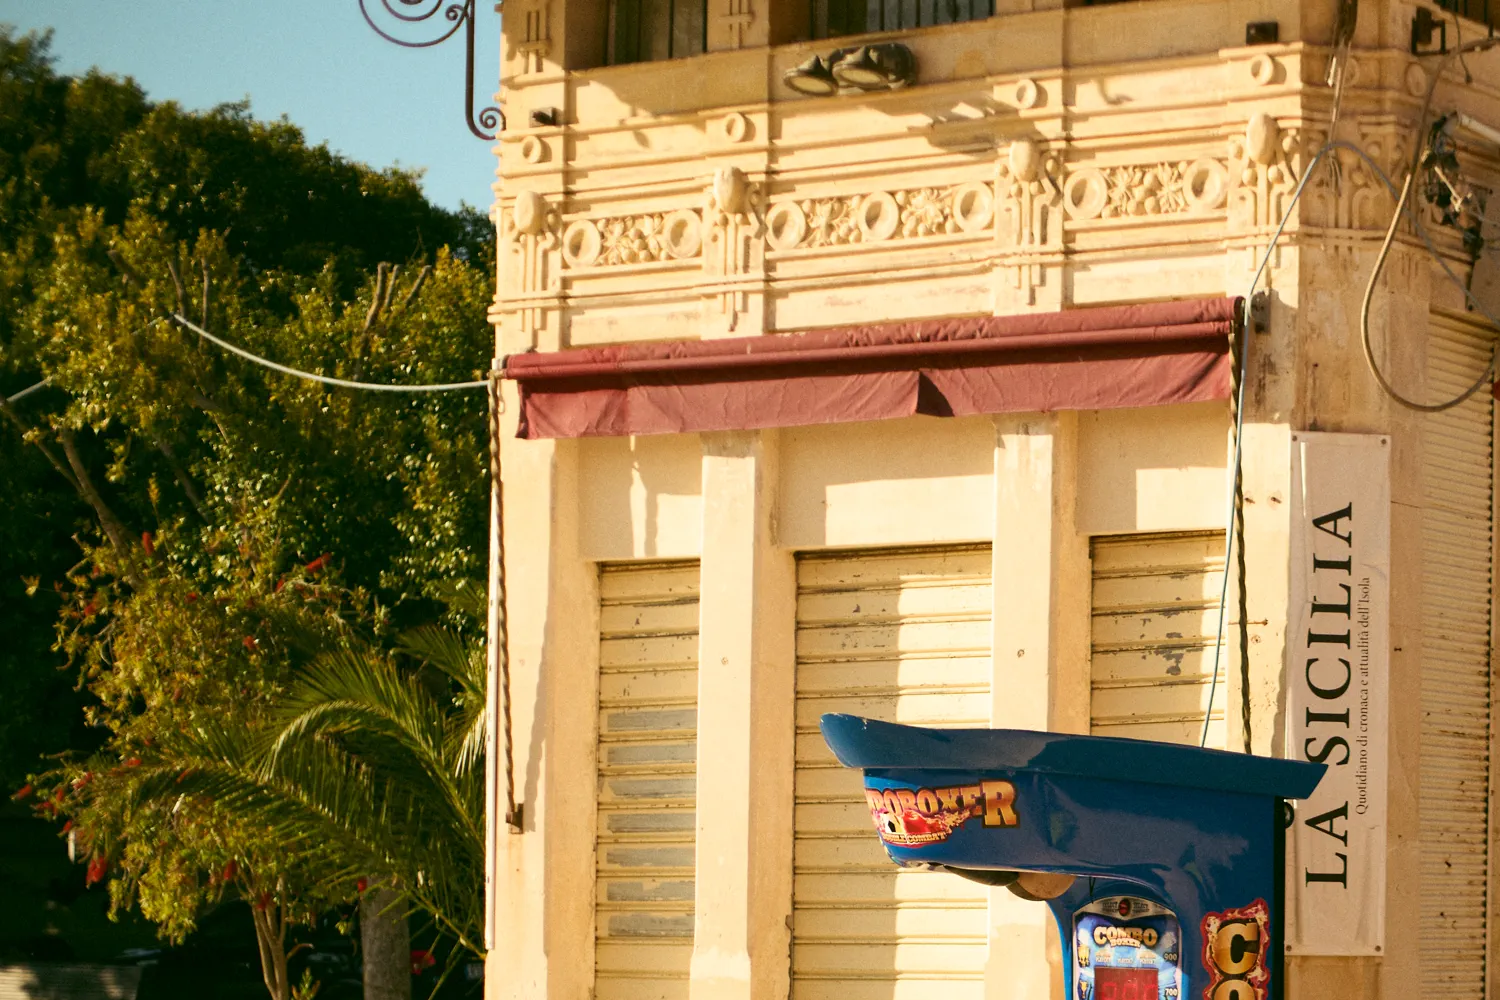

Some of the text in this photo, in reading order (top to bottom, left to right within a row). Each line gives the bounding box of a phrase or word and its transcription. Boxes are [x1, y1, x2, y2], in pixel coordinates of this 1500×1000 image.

[1357, 577, 1371, 630] dell'Isola
[1356, 631, 1370, 676] attualità
[1304, 501, 1353, 890] LA SICILIA
[1359, 692, 1369, 733] cronaca
[1355, 735, 1369, 747] di
[1355, 749, 1369, 816] Quotidiano
[1093, 926, 1158, 947] COMBO
[1163, 953, 1178, 961] 900
[1164, 987, 1178, 997] 700
